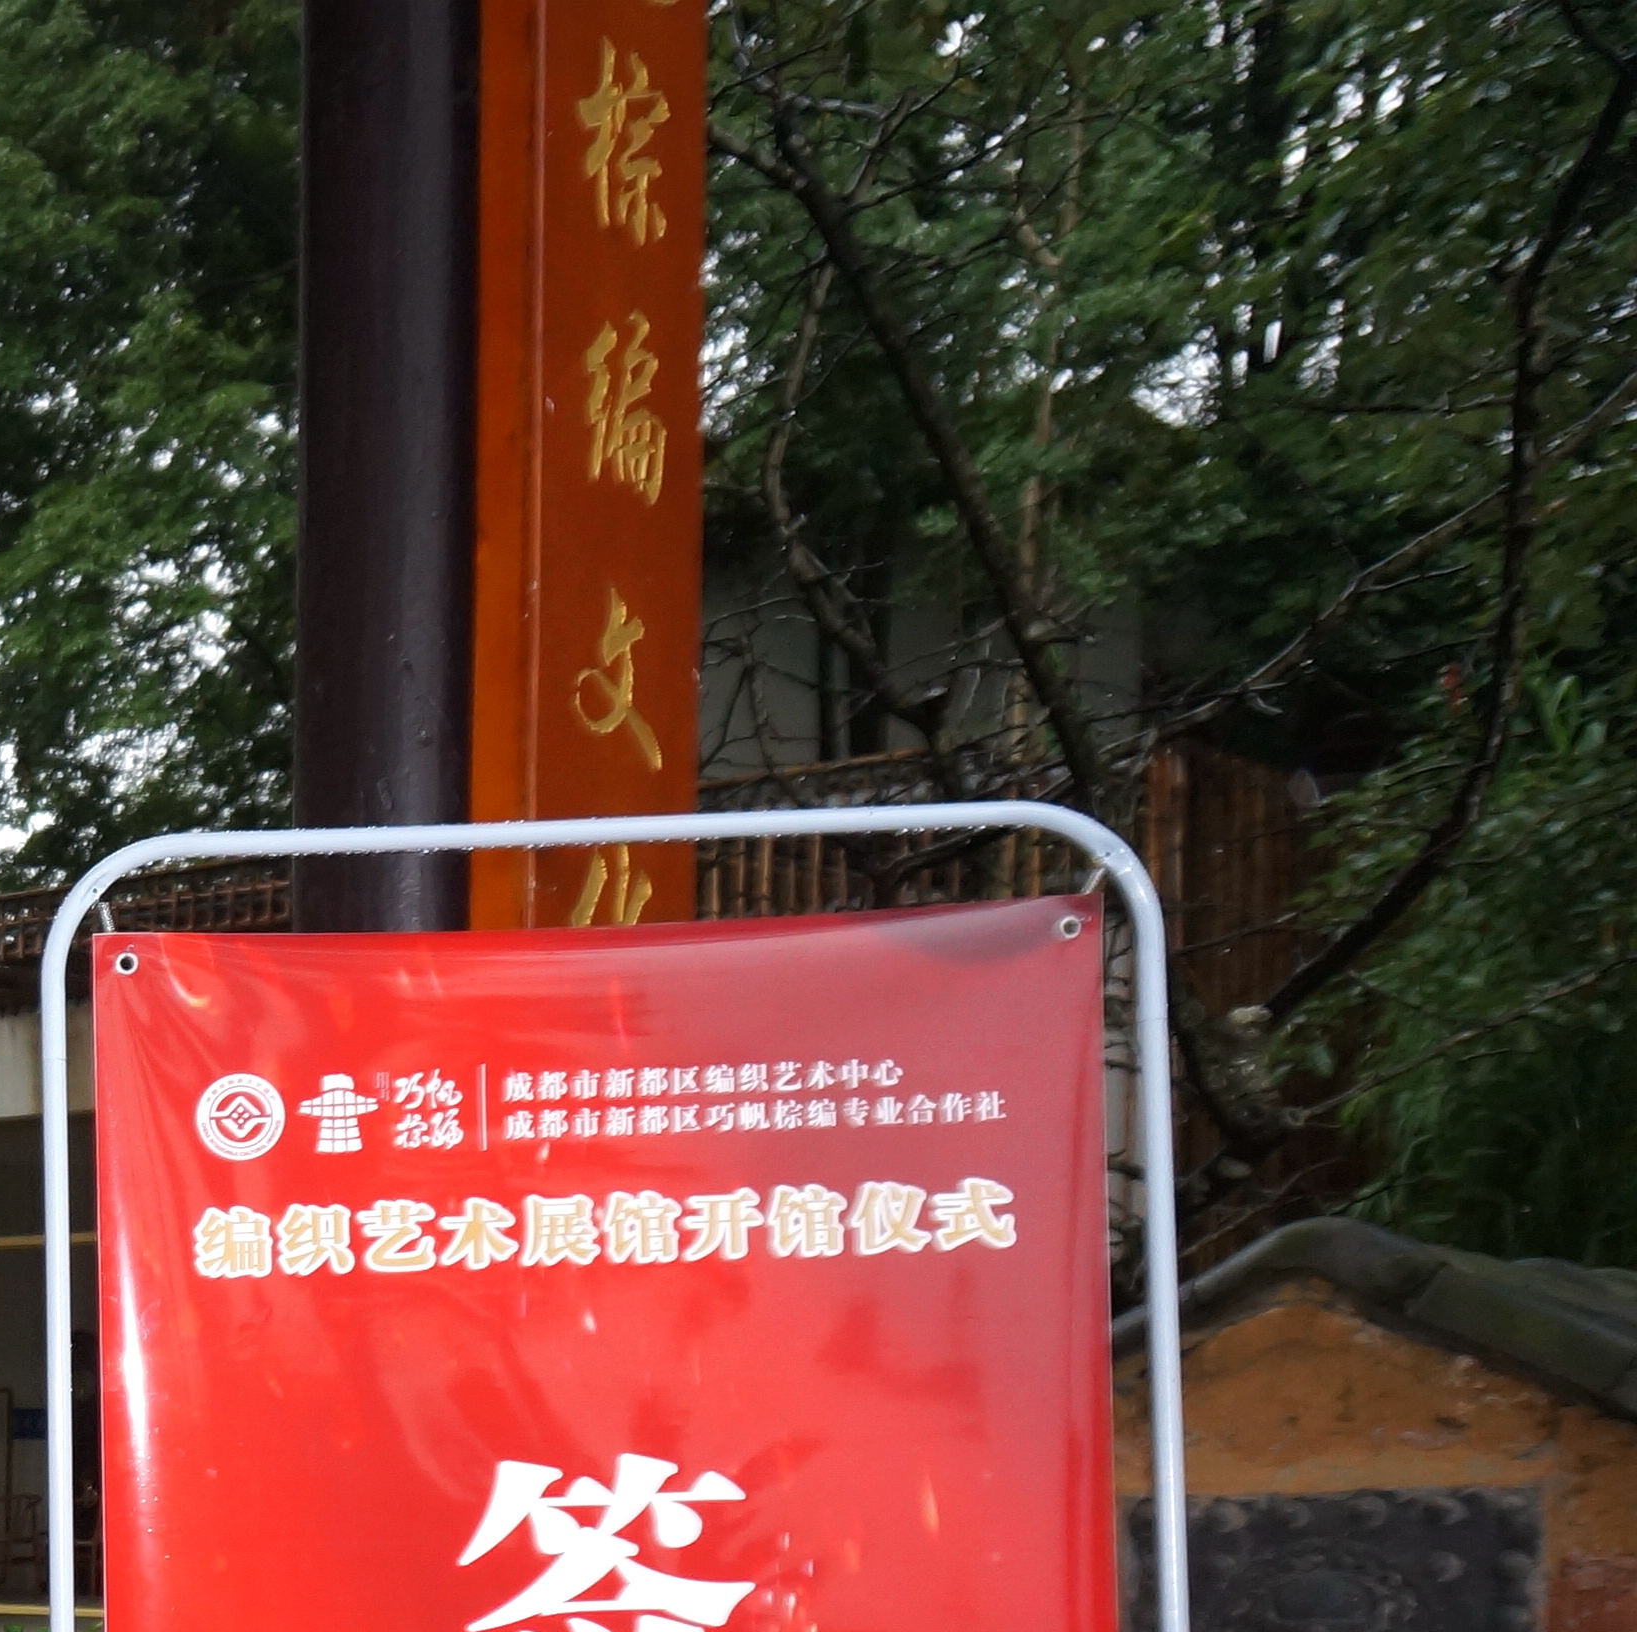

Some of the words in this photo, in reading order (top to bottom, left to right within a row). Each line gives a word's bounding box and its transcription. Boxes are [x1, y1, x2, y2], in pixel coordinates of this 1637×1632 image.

[505, 1058, 904, 1102] 成都市新都区编织艺术中心
[505, 1089, 1007, 1140] 成都市新都区巧帆棕编专业合作社
[193, 1177, 1017, 1281] 编织艺术展馆开馆仪式
